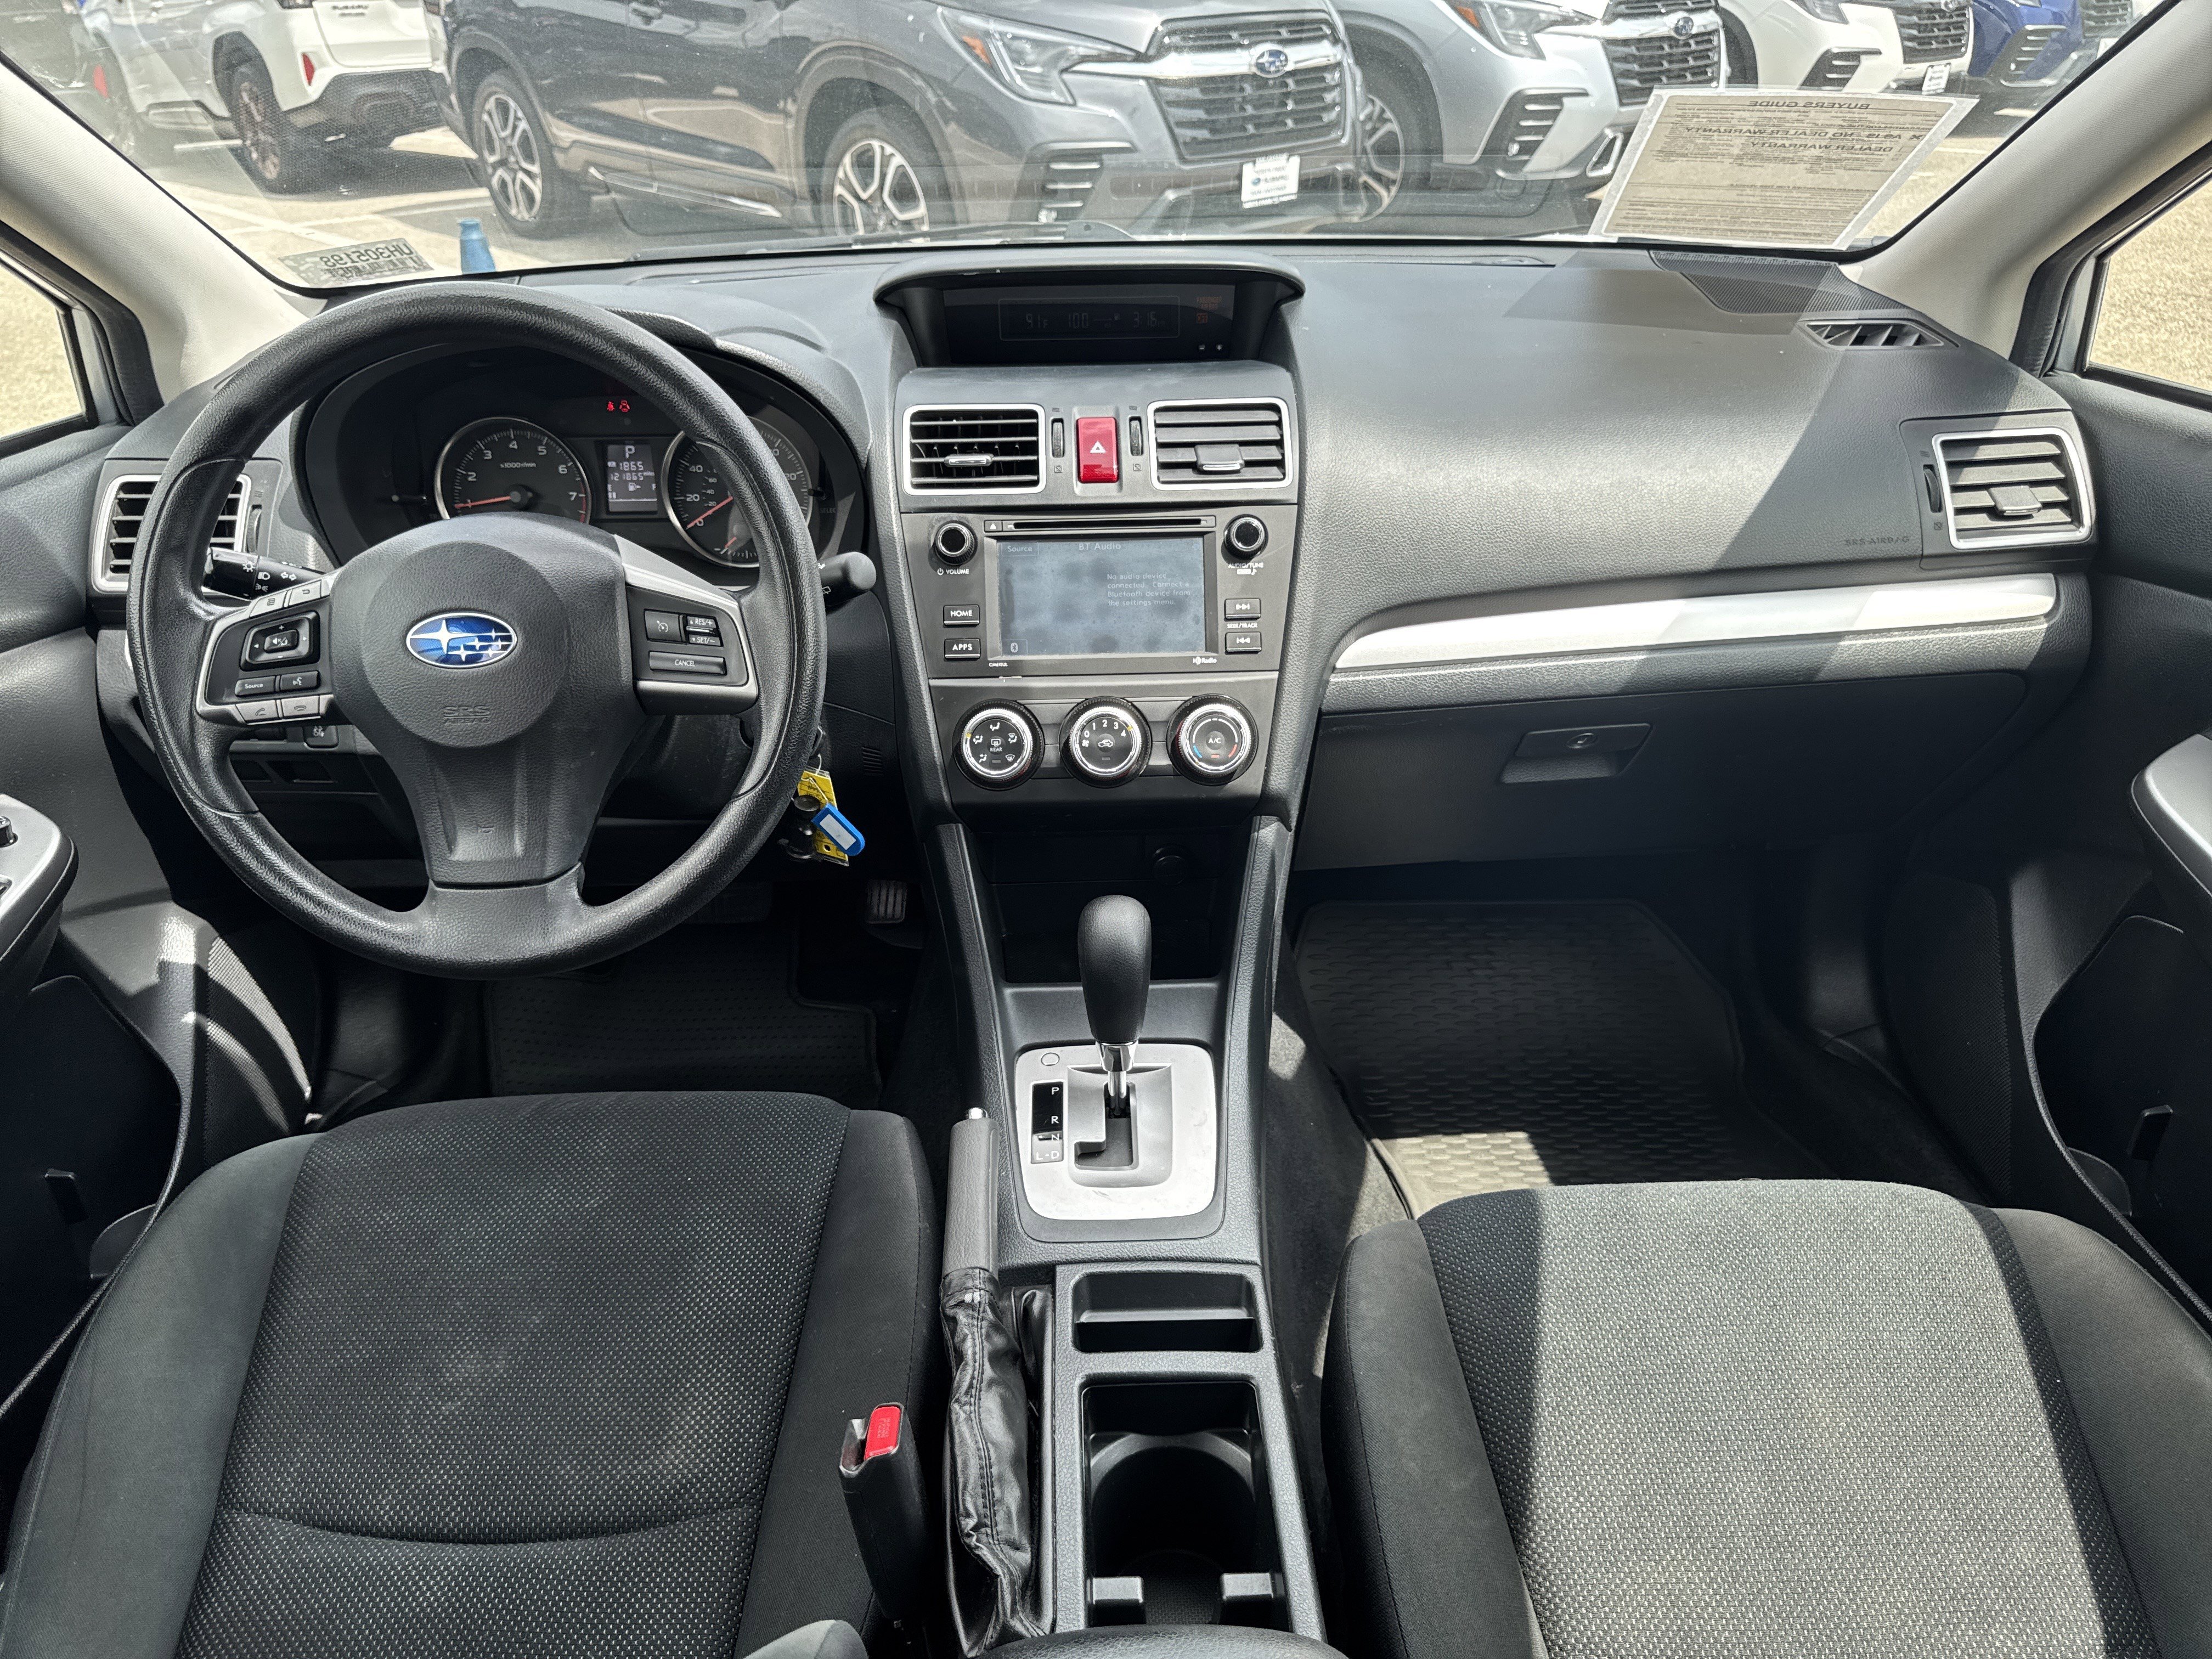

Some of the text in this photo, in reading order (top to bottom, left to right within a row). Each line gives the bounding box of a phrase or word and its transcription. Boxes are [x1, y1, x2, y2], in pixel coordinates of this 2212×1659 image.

[509, 441, 518, 450] 4
[538, 445, 547, 455] 5
[483, 450, 492, 459] 3
[625, 445, 635, 459] P
[558, 465, 568, 473] 6
[467, 472, 477, 481] 2
[568, 492, 578, 500] 7
[674, 659, 696, 667] CANCEL
[442, 705, 490, 716] SRS
[1084, 719, 1126, 738] 0 1 2 3 4
